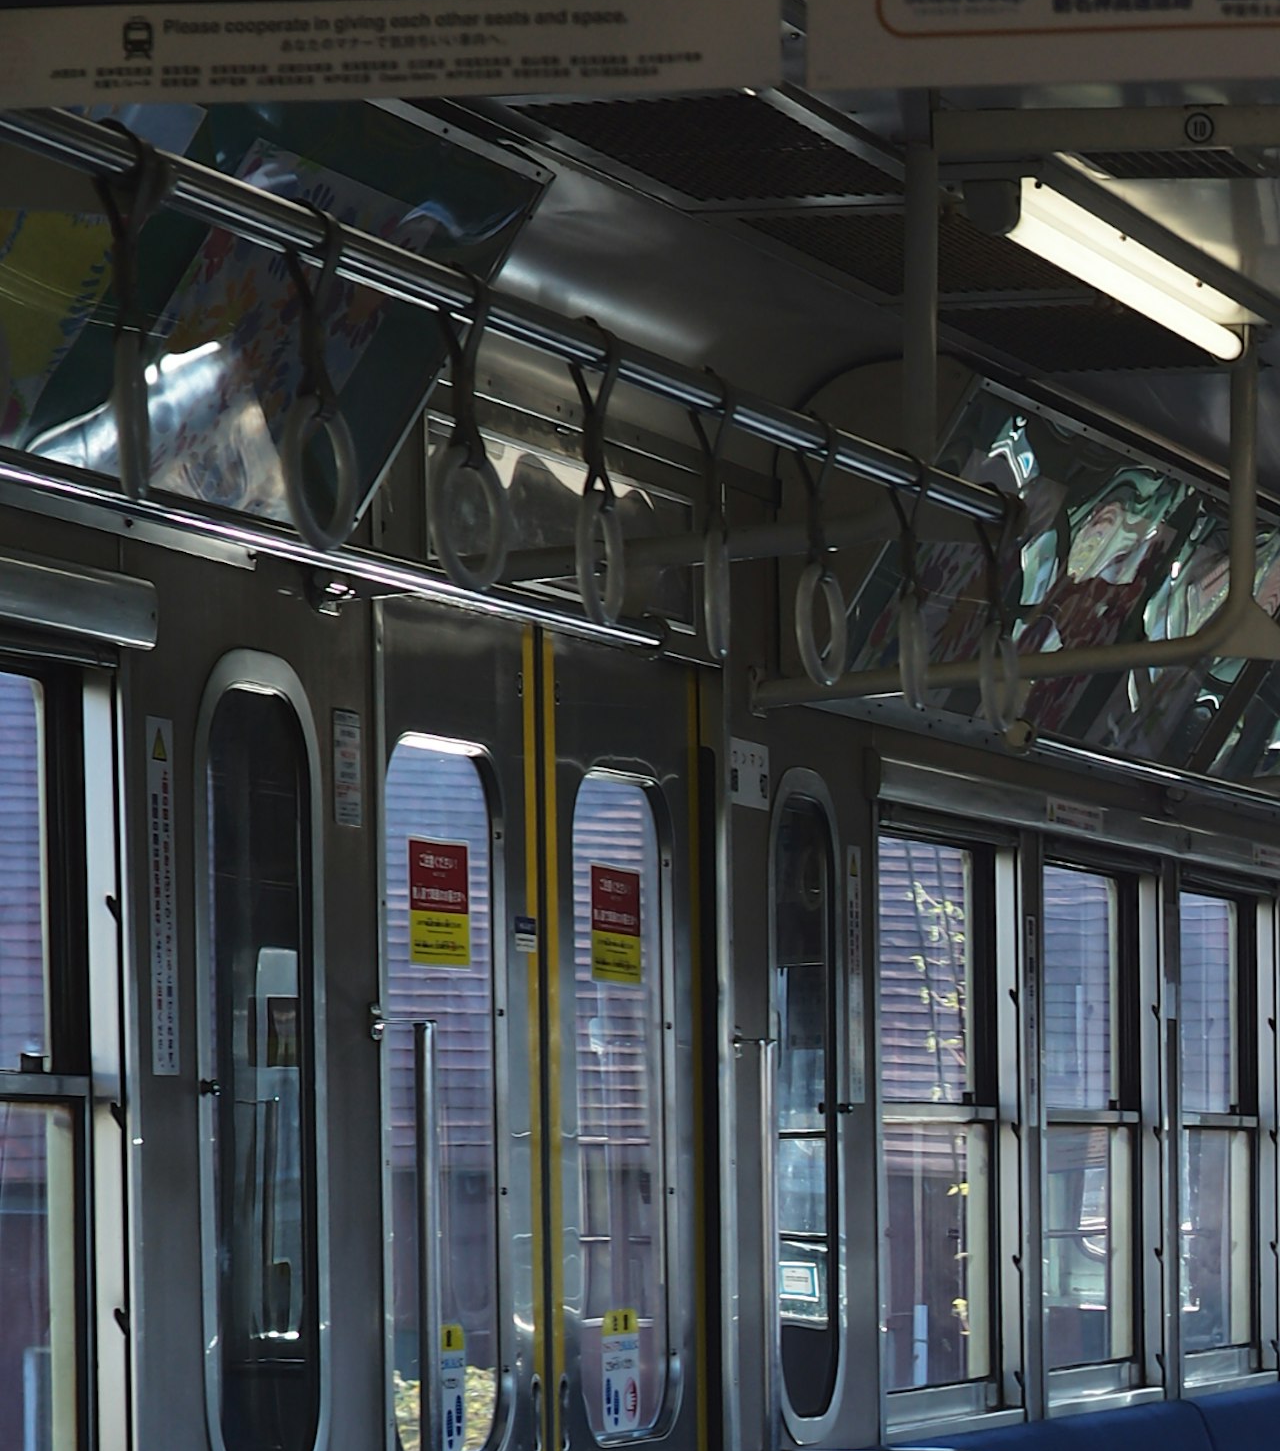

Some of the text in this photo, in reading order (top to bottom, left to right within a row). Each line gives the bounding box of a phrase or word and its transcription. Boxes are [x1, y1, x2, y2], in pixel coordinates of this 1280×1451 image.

[163, 10, 628, 37] Please cooperate in giving each other seats and space.
